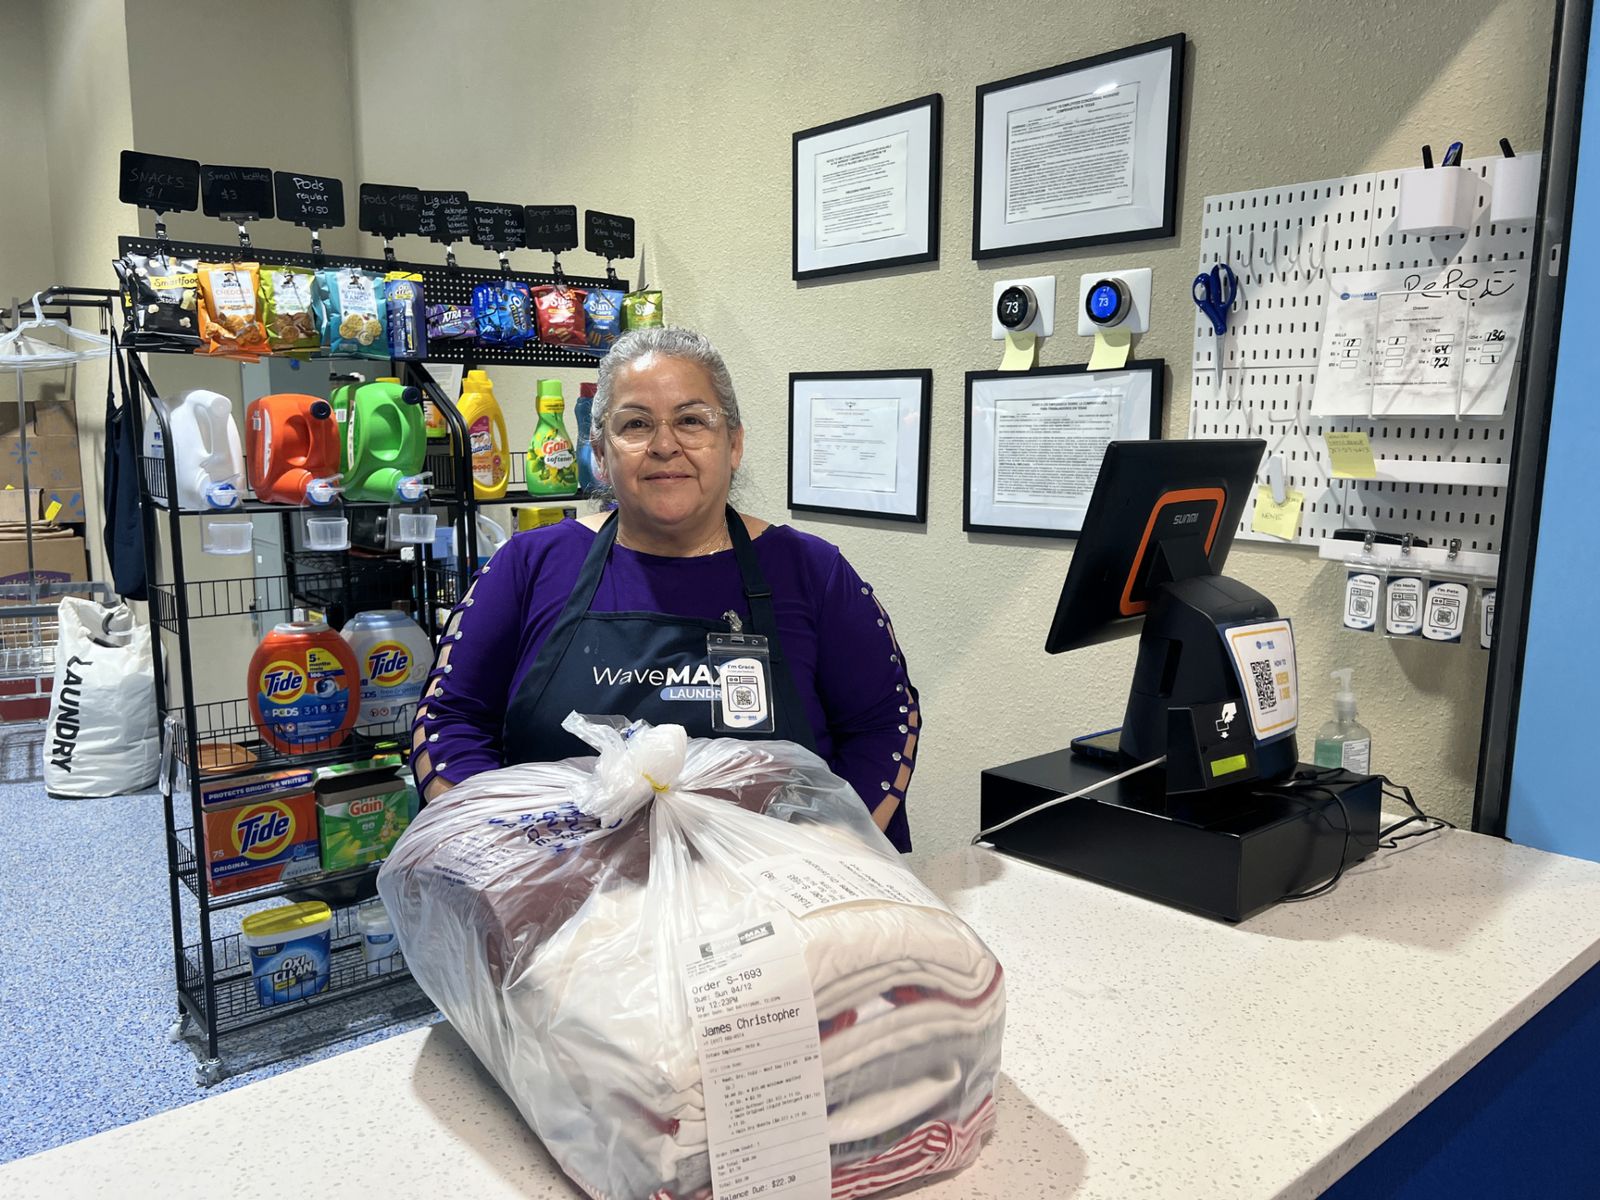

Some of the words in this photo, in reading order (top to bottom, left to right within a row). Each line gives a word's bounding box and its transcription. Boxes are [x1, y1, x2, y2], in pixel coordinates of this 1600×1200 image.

[129, 168, 185, 189] SNACKS
[208, 171, 238, 181] Small
[221, 188, 238, 200] $3
[296, 191, 329, 203] regular
[589, 300, 612, 312] Sun
[1006, 302, 1019, 314] 73
[1098, 298, 1109, 307] 73
[442, 309, 462, 323] XTRA
[1486, 329, 1505, 342] 136
[1434, 345, 1449, 354] 64
[1434, 357, 1449, 368] 72
[543, 440, 568, 455] Gain
[546, 456, 572, 465] softener
[368, 650, 409, 680] Tide
[264, 670, 303, 697] Tide
[669, 688, 722, 699] LAUNDR
[50, 655, 94, 774] LAUNDRY
[272, 707, 299, 717] PODS
[208, 788, 244, 800] PROTECTS
[349, 800, 383, 817] Gain
[236, 811, 291, 855] Tide
[213, 861, 249, 873] ORIGINAL
[282, 954, 306, 970] OXI
[273, 961, 314, 983] CLEAN
[691, 979, 721, 995] Order
[726, 968, 763, 985] S-1693
[693, 992, 711, 1004] Due:
[714, 988, 728, 999] Sun
[730, 982, 752, 995] 04/12
[696, 1003, 706, 1014] by
[708, 996, 739, 1010] 12:23PM
[701, 1021, 732, 1038] James
[736, 1007, 801, 1030] Christopher
[752, 1184, 769, 1195] Due:
[771, 1174, 797, 1189] $22.30
